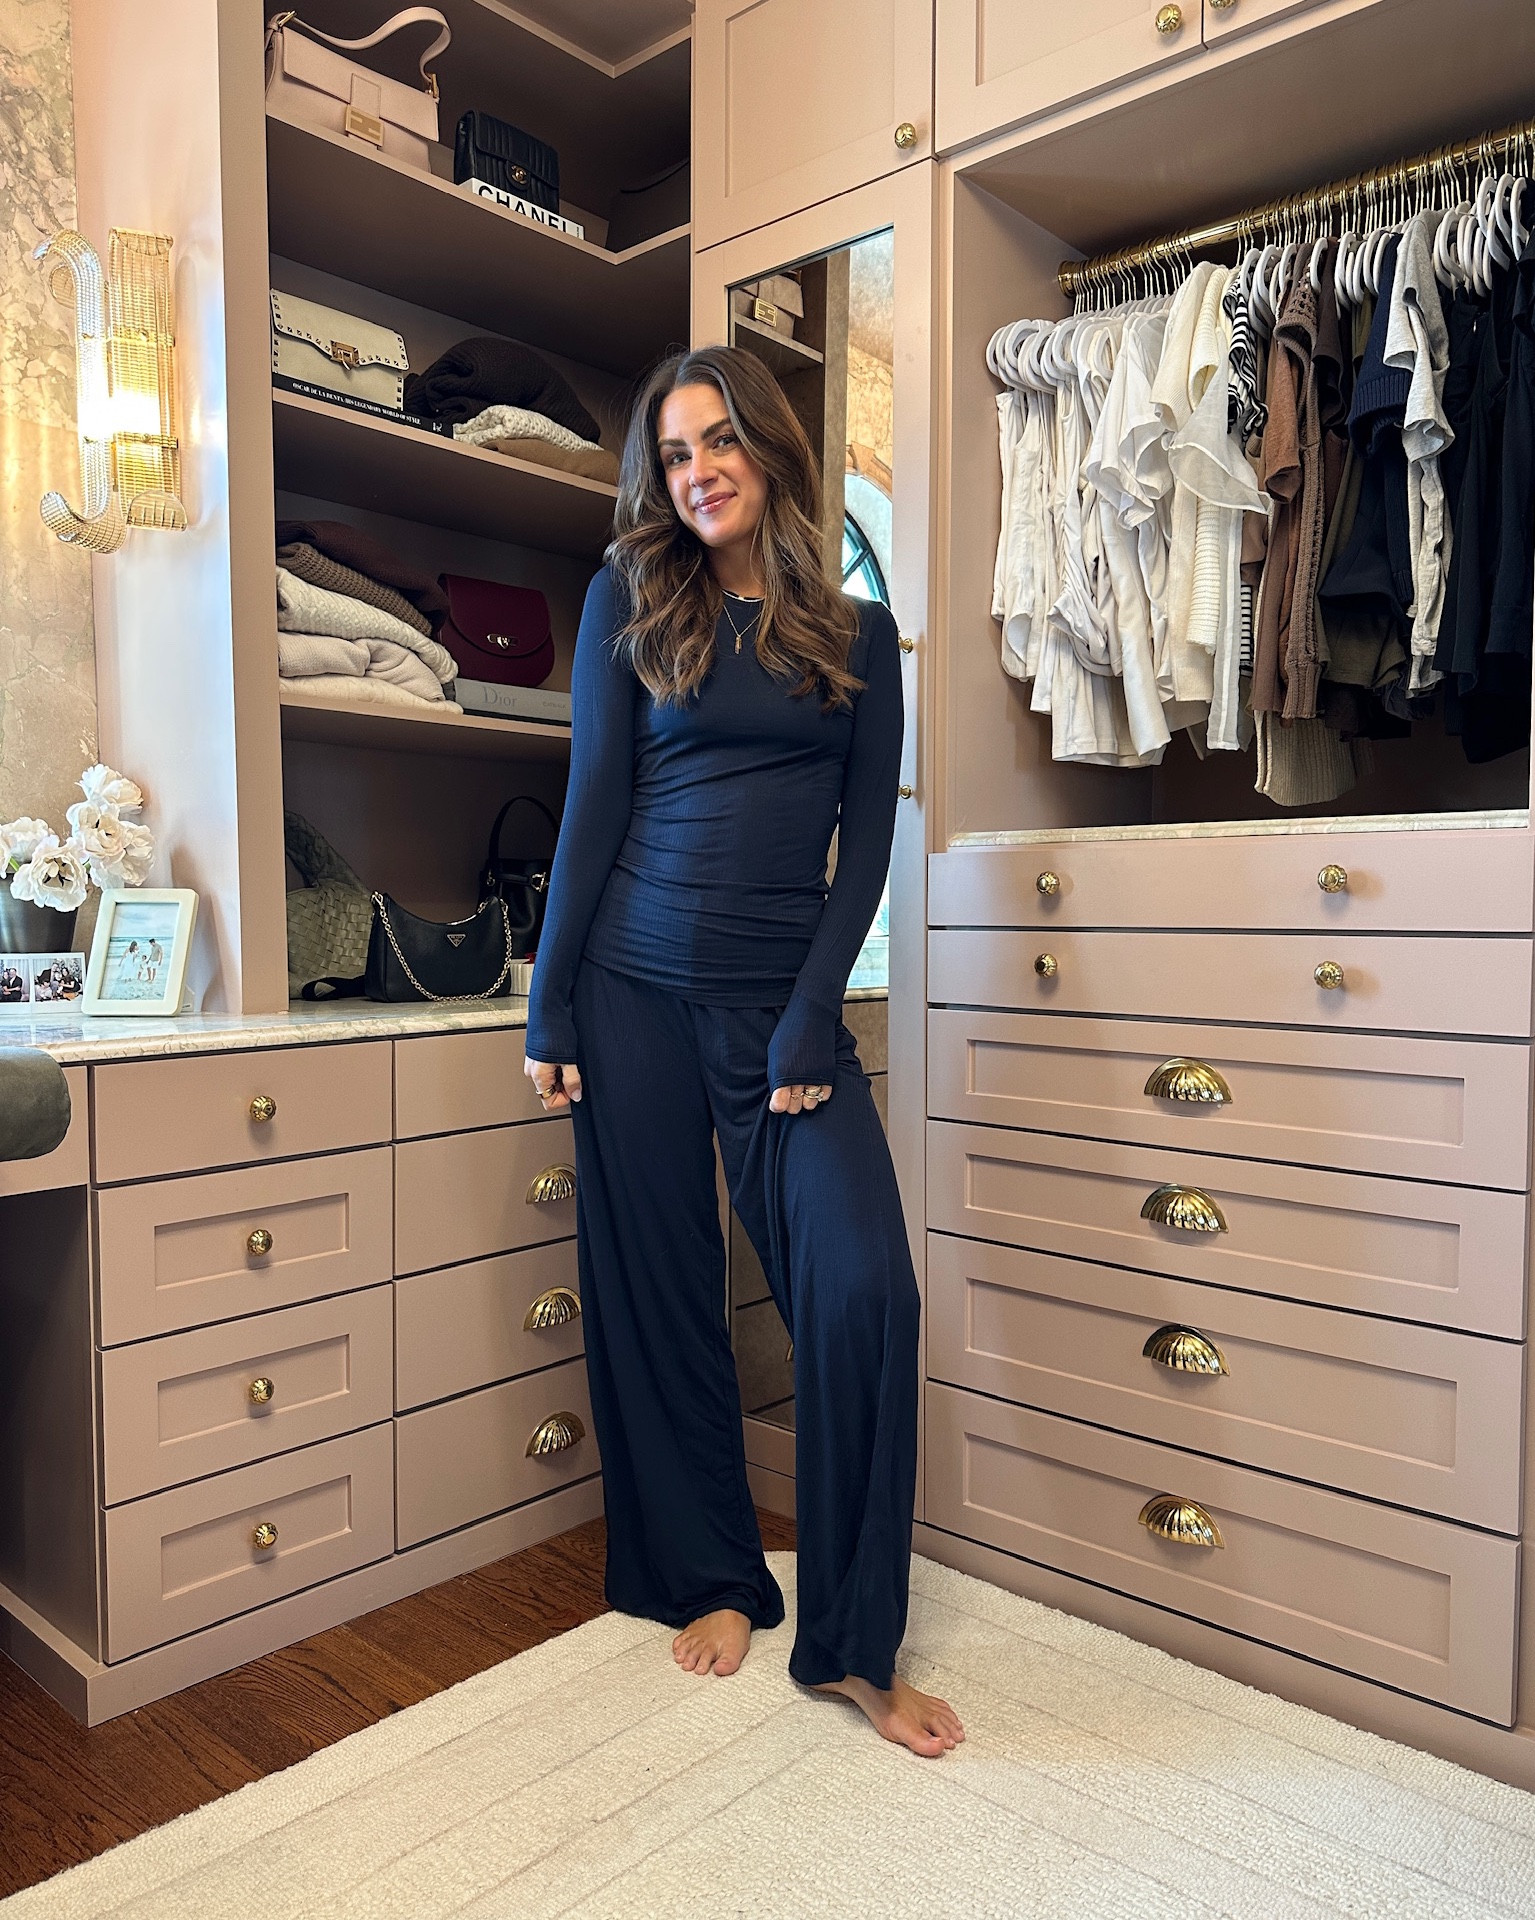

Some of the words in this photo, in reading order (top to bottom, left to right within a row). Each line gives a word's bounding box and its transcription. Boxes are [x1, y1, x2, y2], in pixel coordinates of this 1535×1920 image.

[292, 382, 310, 392] OSCAR
[310, 387, 319, 395] DE
[318, 390, 326, 398] LA
[354, 400, 381, 413] LEGENDARY
[382, 408, 400, 418] WORLD
[406, 415, 421, 425] STYLE
[482, 686, 518, 707] Dior
